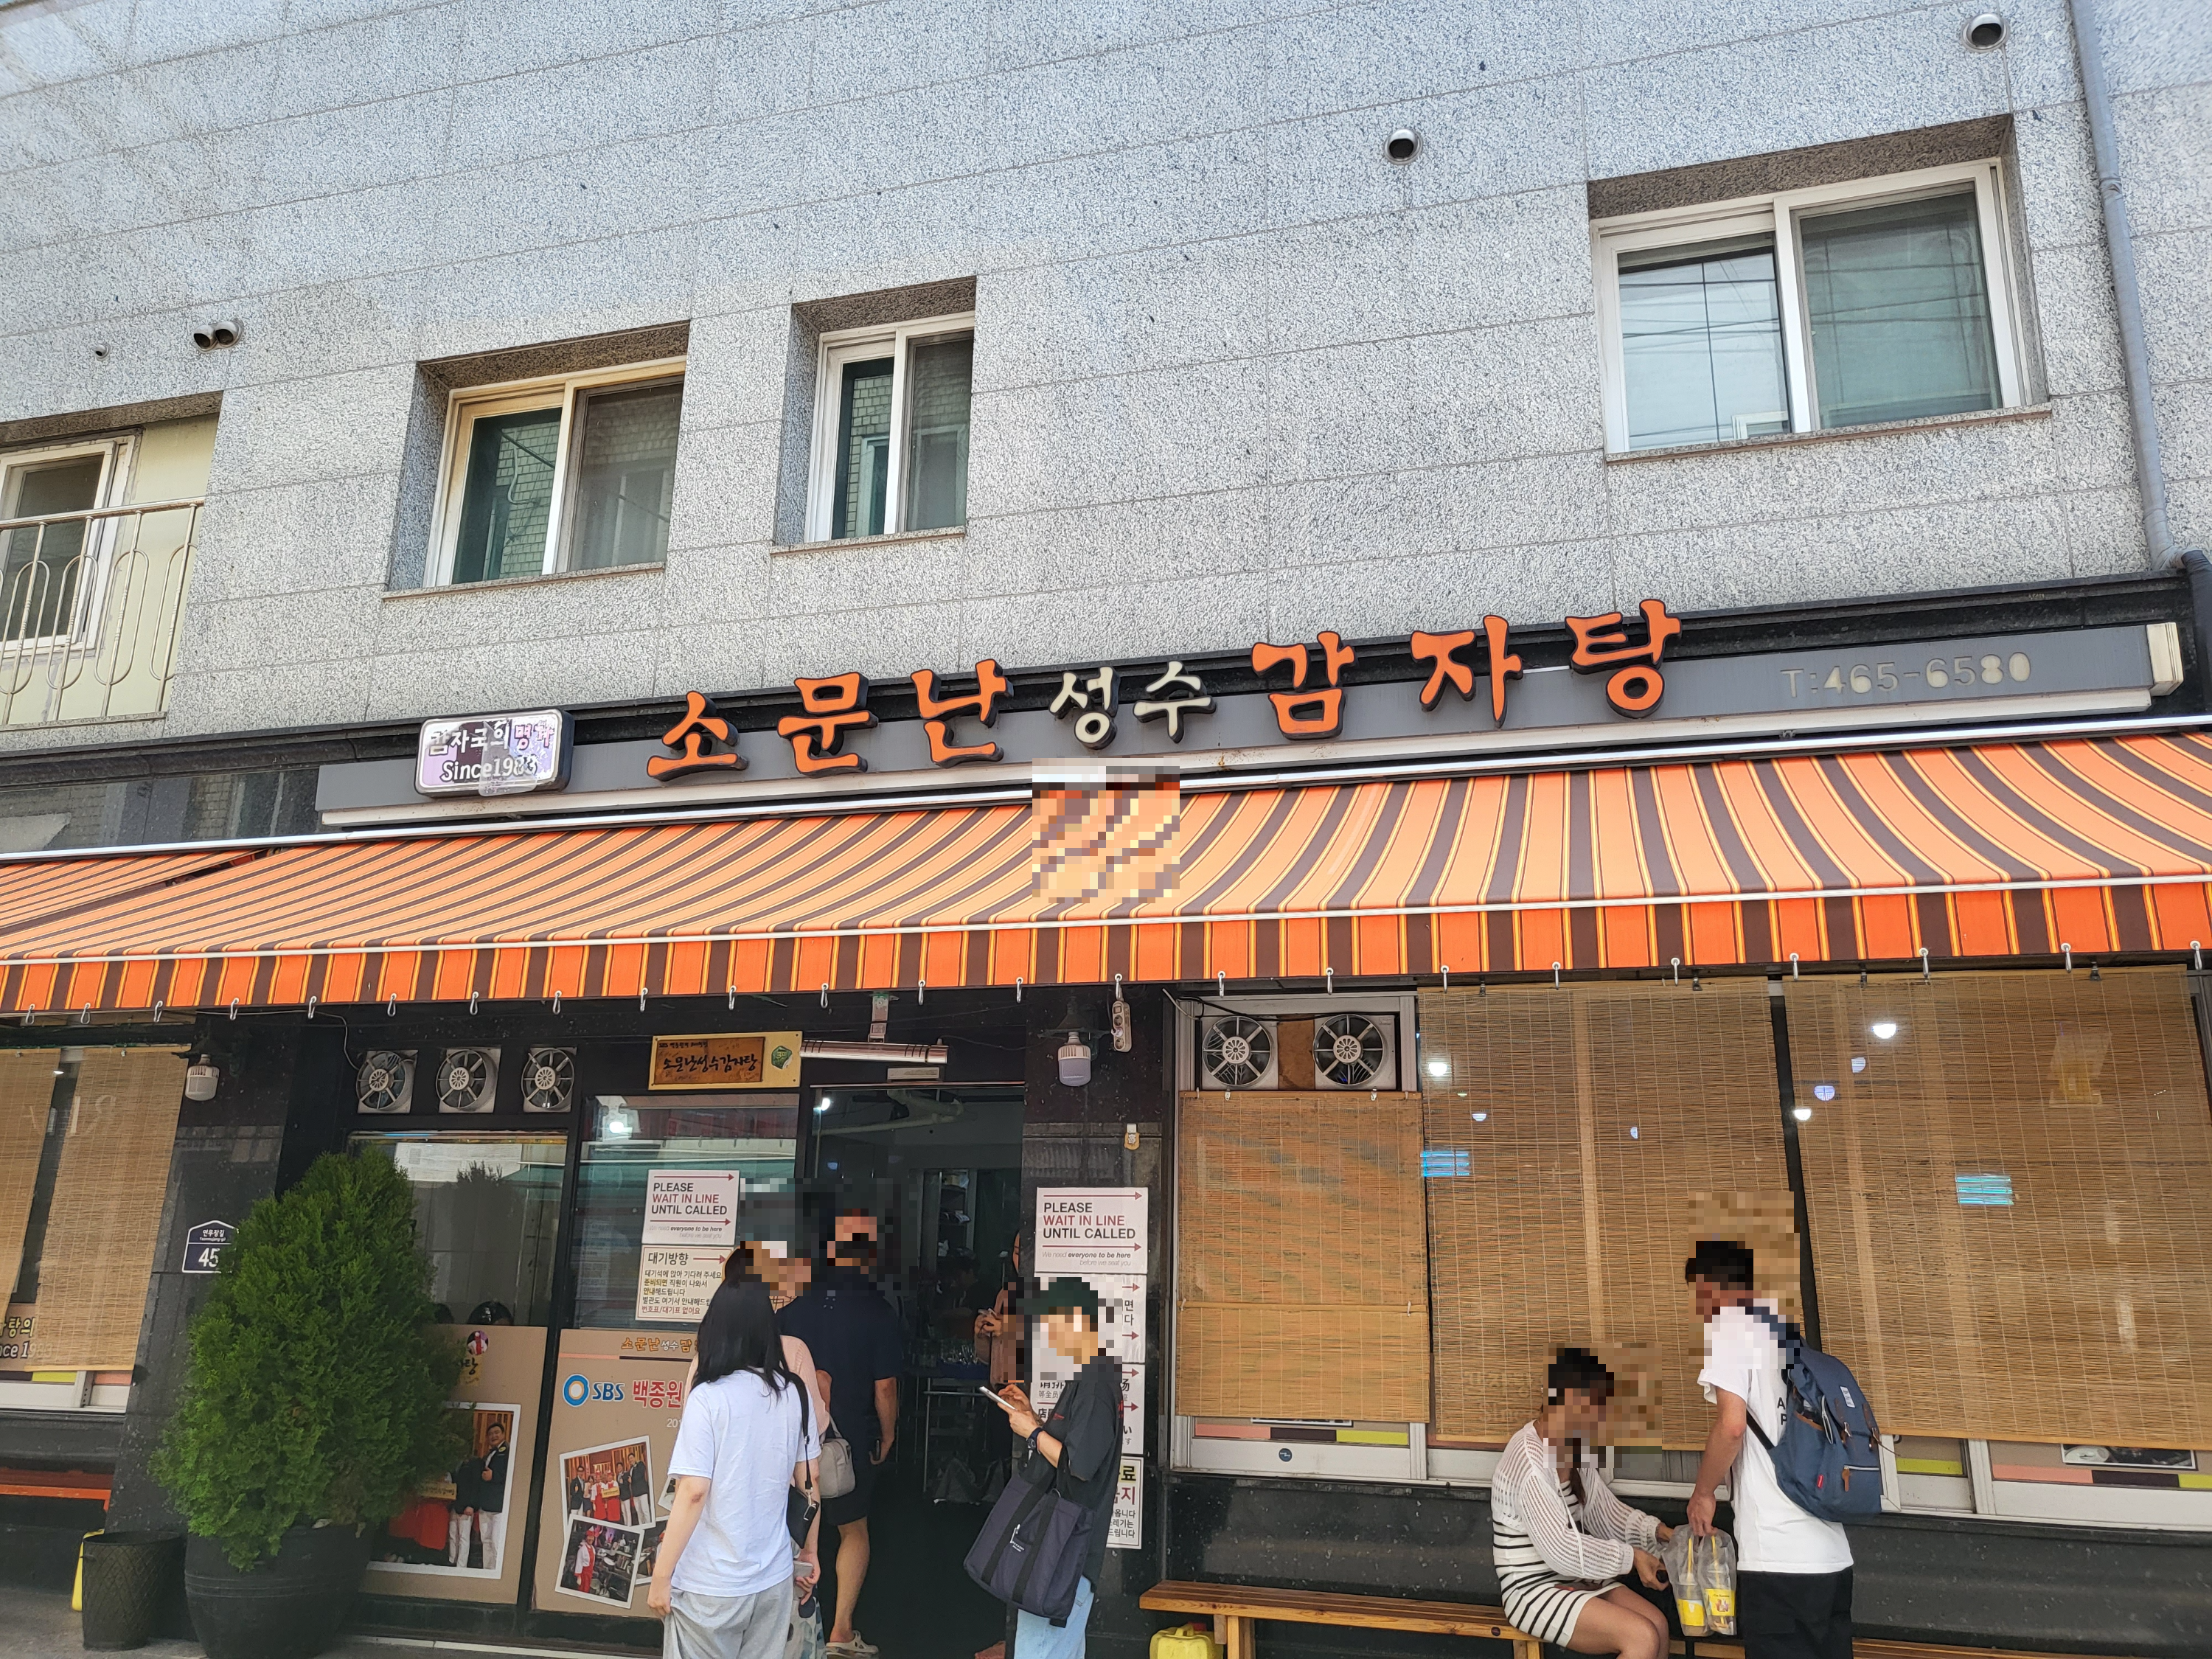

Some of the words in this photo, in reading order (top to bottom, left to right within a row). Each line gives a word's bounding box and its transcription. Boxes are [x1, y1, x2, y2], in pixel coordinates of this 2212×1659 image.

[1781, 651, 2031, 698] T:465-6580
[646, 658, 1013, 782] 소문난
[1048, 661, 1217, 750] 성수
[1251, 599, 1682, 740] 감자탕
[653, 1183, 694, 1192] PLEASE
[653, 1194, 679, 1203] WAIT
[681, 1194, 692, 1203] IN
[695, 1194, 720, 1203] LINE
[651, 1205, 682, 1214] UNTIL
[685, 1205, 727, 1215] CALLED
[1043, 1202, 1093, 1213] PLEASE
[1043, 1215, 1075, 1225] WAIT
[1079, 1215, 1091, 1225] IN
[1096, 1215, 1125, 1225] LINE
[202, 1229, 225, 1238] 연무장길
[1043, 1228, 1080, 1239] UNTIL
[1085, 1228, 1135, 1239] CALLED
[198, 1248, 220, 1267] 45
[648, 1252, 689, 1266] 대기방향
[644, 1270, 669, 1278] 대기석에
[684, 1270, 702, 1279] 기다려
[703, 1270, 722, 1279] 주세요
[644, 1279, 668, 1287] 준비되면
[669, 1279, 687, 1287] 직원이
[689, 1280, 708, 1288] 나와서
[662, 1297, 680, 1305] 여기서
[621, 1337, 660, 1352] 소문난
[661, 1340, 679, 1352] 성수
[591, 1382, 625, 1402] SBS
[632, 1379, 684, 1410] 백종원
[1119, 1465, 1136, 1481] 료
